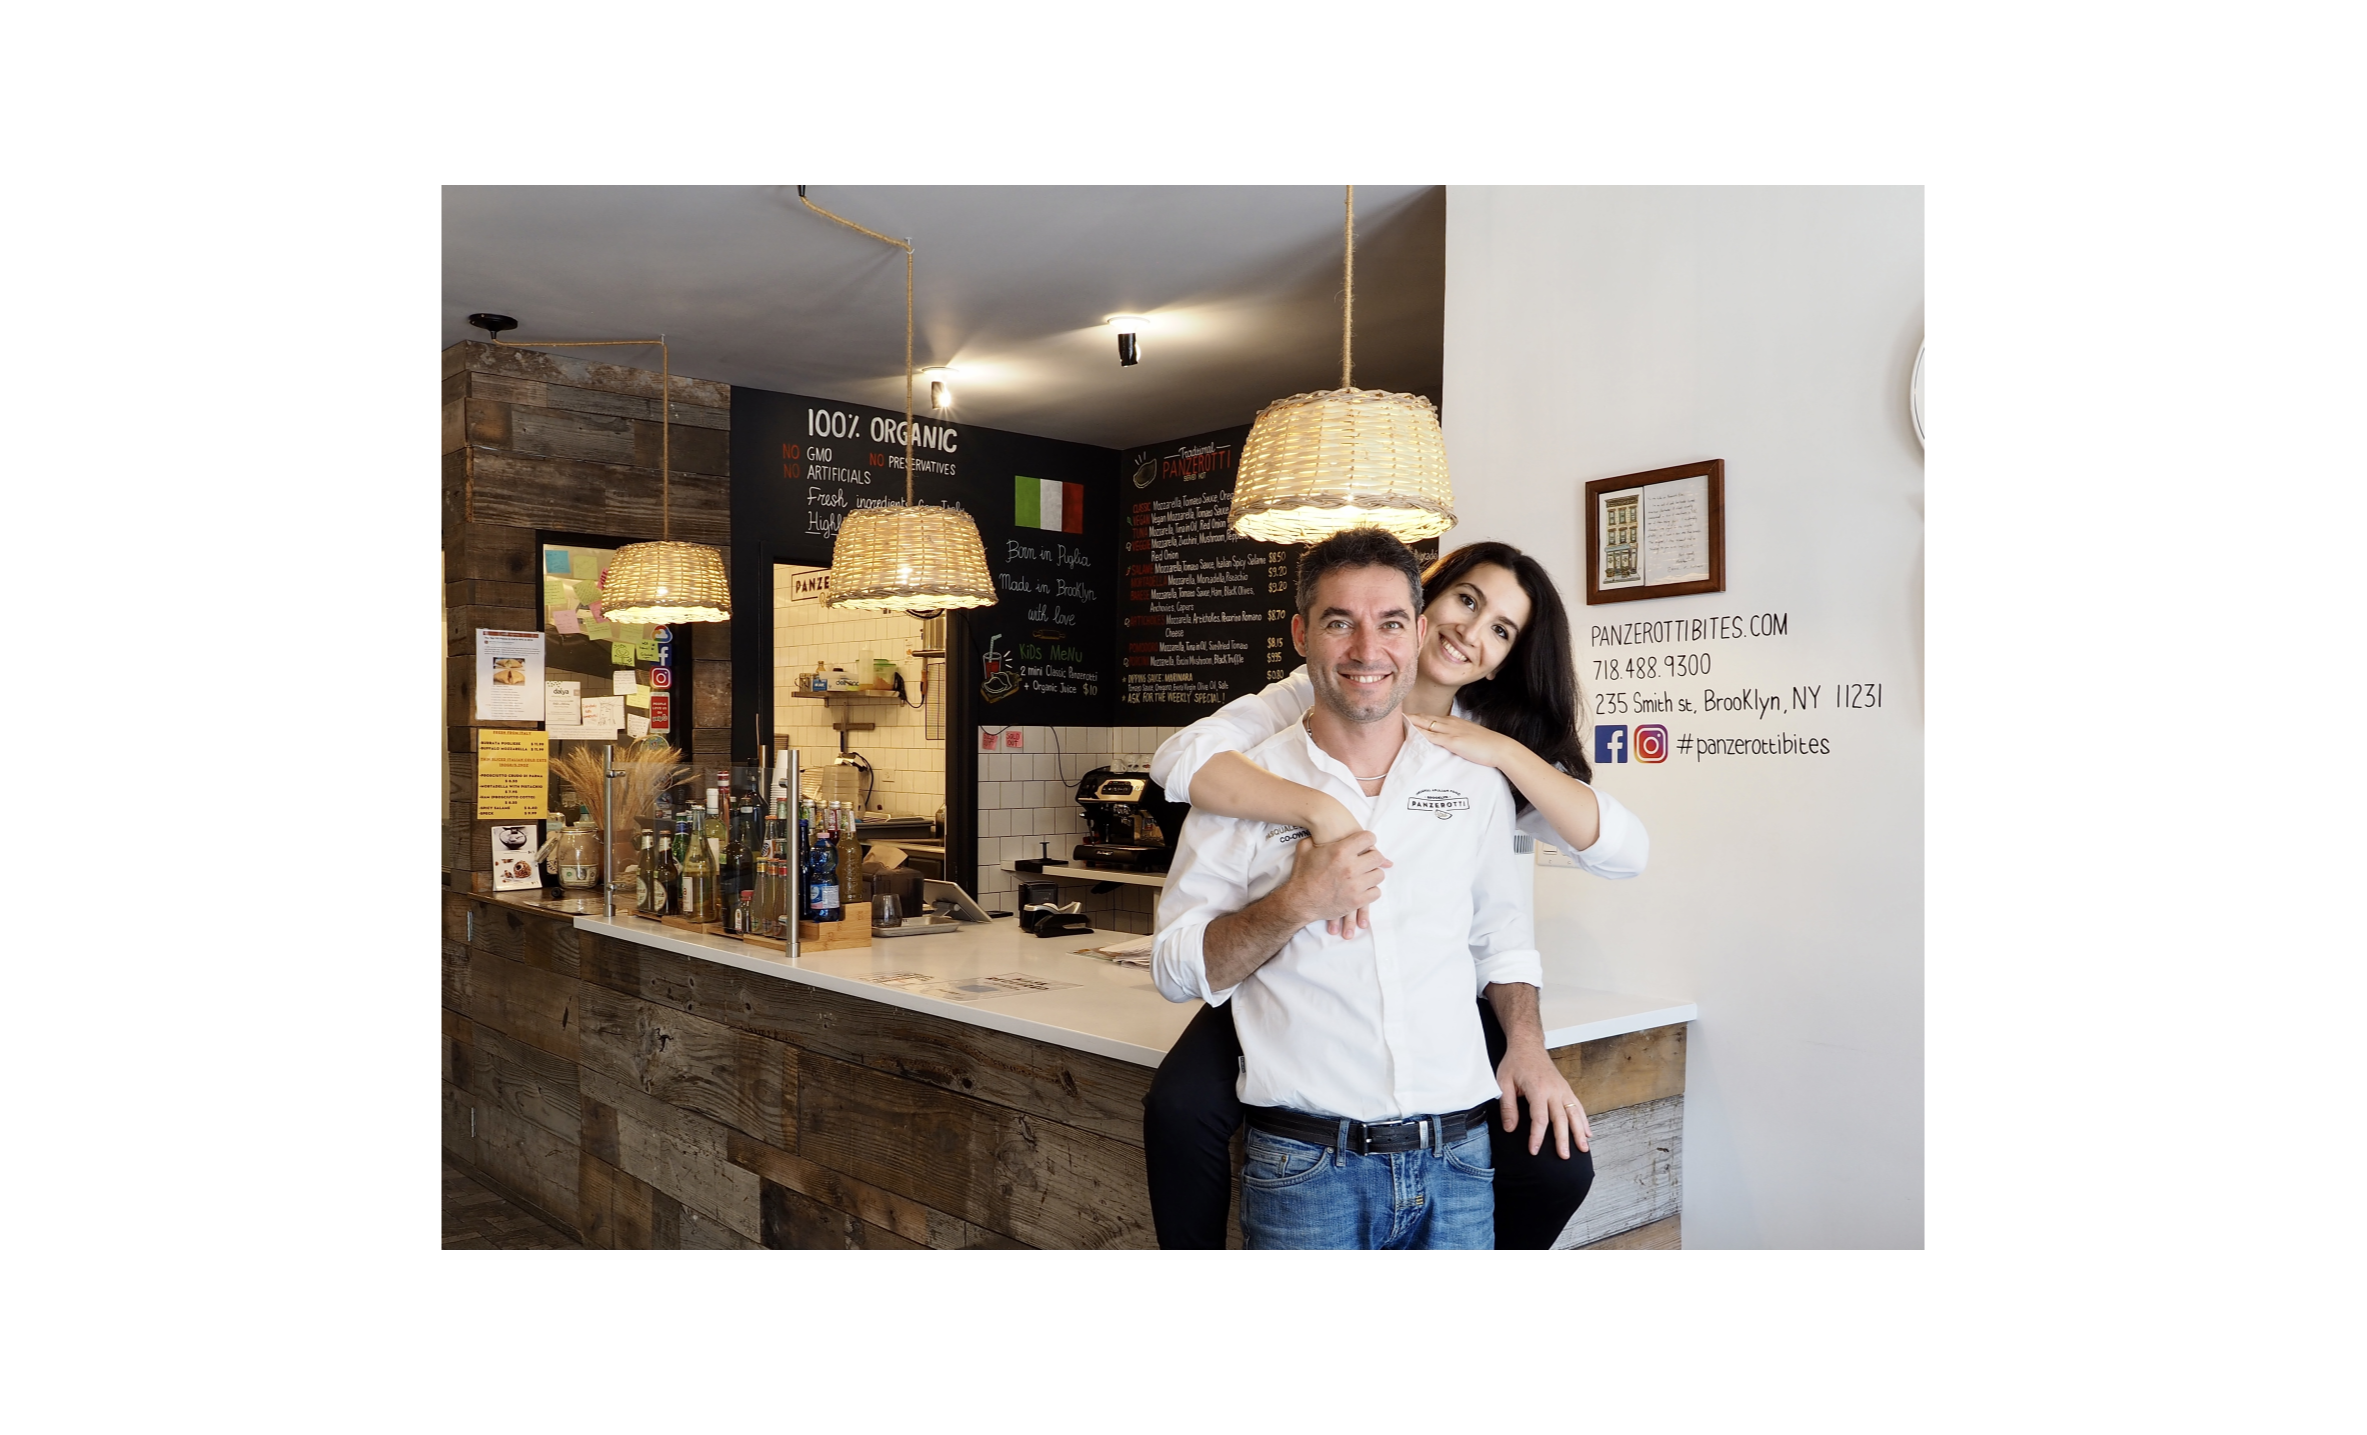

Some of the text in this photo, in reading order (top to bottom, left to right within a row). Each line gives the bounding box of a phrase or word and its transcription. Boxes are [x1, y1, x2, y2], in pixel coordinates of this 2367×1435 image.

[808, 408, 958, 453] 100% ORGANIC
[783, 443, 833, 462] NO GMO
[869, 453, 885, 468] NO
[1162, 449, 1231, 480] PANZEROTTI
[784, 463, 871, 485] NO ARTIFICIALS
[807, 486, 848, 508] Fresh
[1133, 501, 1151, 514] CLASSIC
[1132, 514, 1151, 527] VEGAN
[1151, 512, 1166, 526] Vegan
[1199, 518, 1211, 531] Red
[1212, 516, 1226, 529] Onion
[1005, 539, 1092, 570] Born in Puglia
[1151, 549, 1179, 562] Red Onion
[1232, 555, 1246, 570] Spicy
[1267, 565, 1287, 577] $9.20
[795, 576, 830, 594] PANZE
[998, 572, 1032, 593] Made
[1035, 579, 1050, 595] in
[1267, 581, 1287, 593] $9.20
[1028, 603, 1077, 626] with love
[1176, 601, 1194, 614] Capers
[1165, 627, 1185, 638] Cheese
[1591, 612, 1789, 648] PANZEROTTIBITES.COM
[1020, 664, 1098, 682] 2 mini Classic Panzerotti
[1593, 652, 1711, 682] 718.488.9300
[1165, 672, 1193, 683] MARINARA
[1032, 680, 1058, 694] Organic
[1060, 681, 1077, 694] Juice
[1082, 682, 1098, 697] $10
[1127, 692, 1140, 704] ASK
[1142, 692, 1154, 703] FOR
[1154, 691, 1165, 703] THE
[1595, 691, 1628, 715] 235
[1633, 690, 1673, 714] Smith
[1792, 684, 1821, 711] NY
[1836, 683, 1883, 709] 11231
[1676, 731, 1831, 763] #panzerottibites
[1411, 800, 1466, 809] PANZEROTTI
[1279, 829, 1312, 843] CO-OWN
